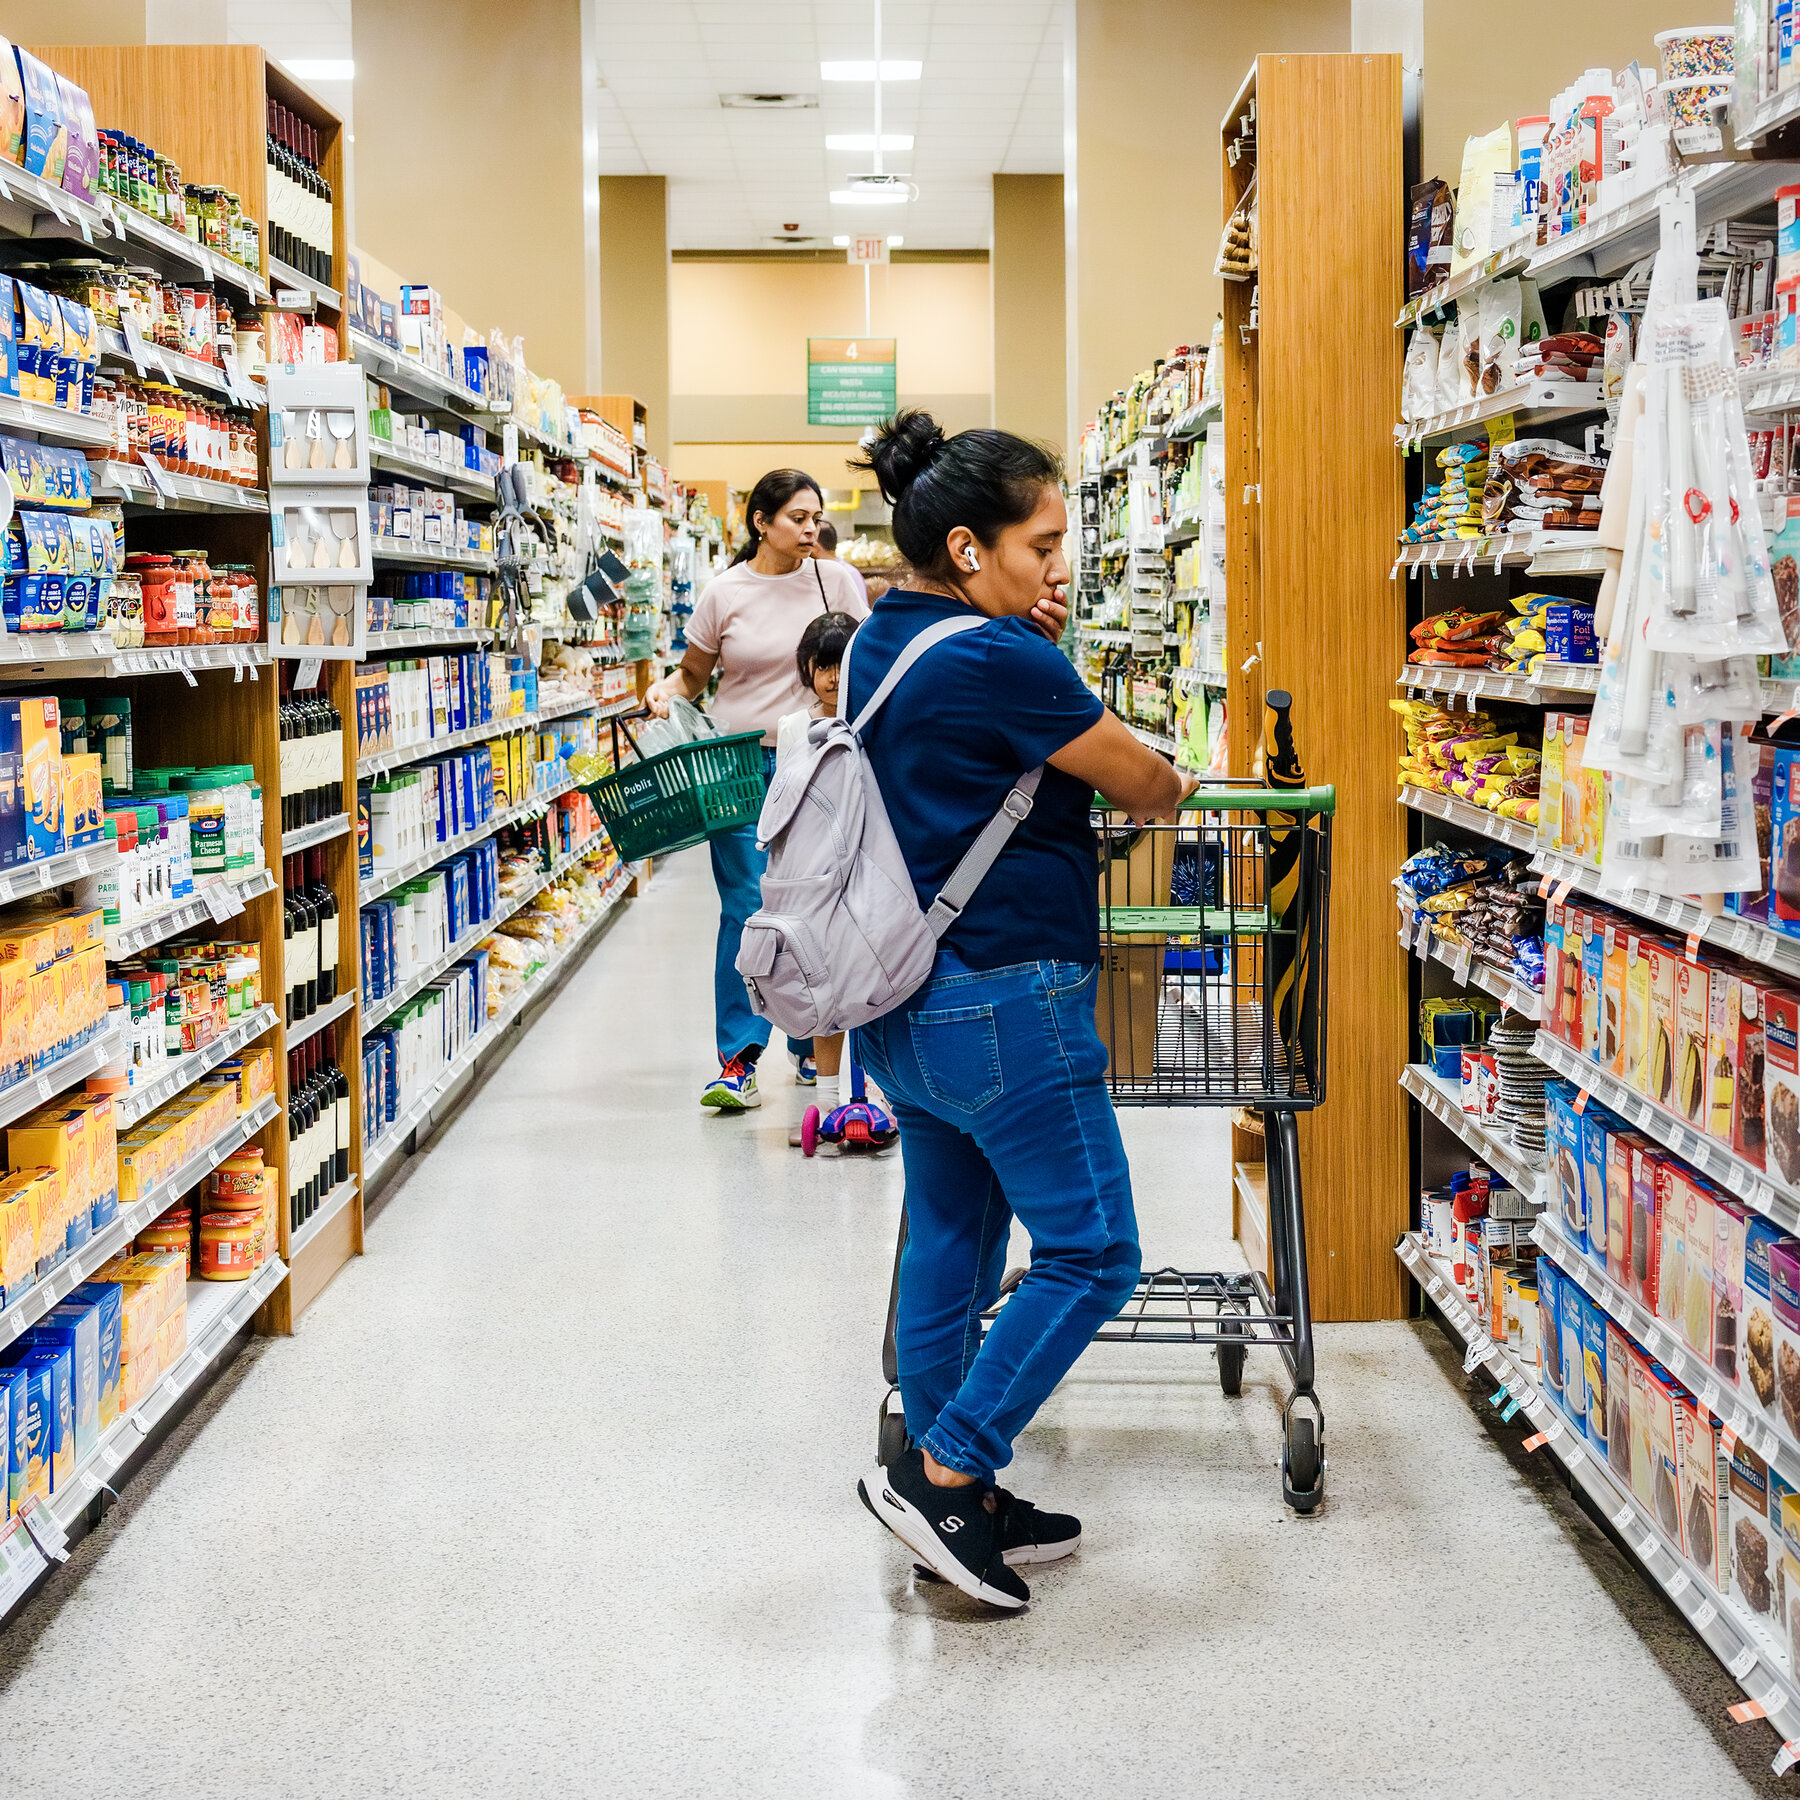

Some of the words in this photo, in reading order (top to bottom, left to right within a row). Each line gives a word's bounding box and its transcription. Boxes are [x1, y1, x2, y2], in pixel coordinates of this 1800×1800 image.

[857, 239, 881, 260] EXIT
[846, 342, 858, 360] 4
[1574, 626, 1590, 634] Foil
[624, 779, 652, 797] Publix
[202, 820, 218, 829] Kraft
[195, 839, 223, 848] Parmesan
[200, 846, 221, 855] Cheese
[1100, 956, 1124, 972] E.
[1766, 1024, 1796, 1046] GHIRARDELLI
[1747, 1249, 1770, 1275] GHIRARDE
[939, 1515, 965, 1533] S
